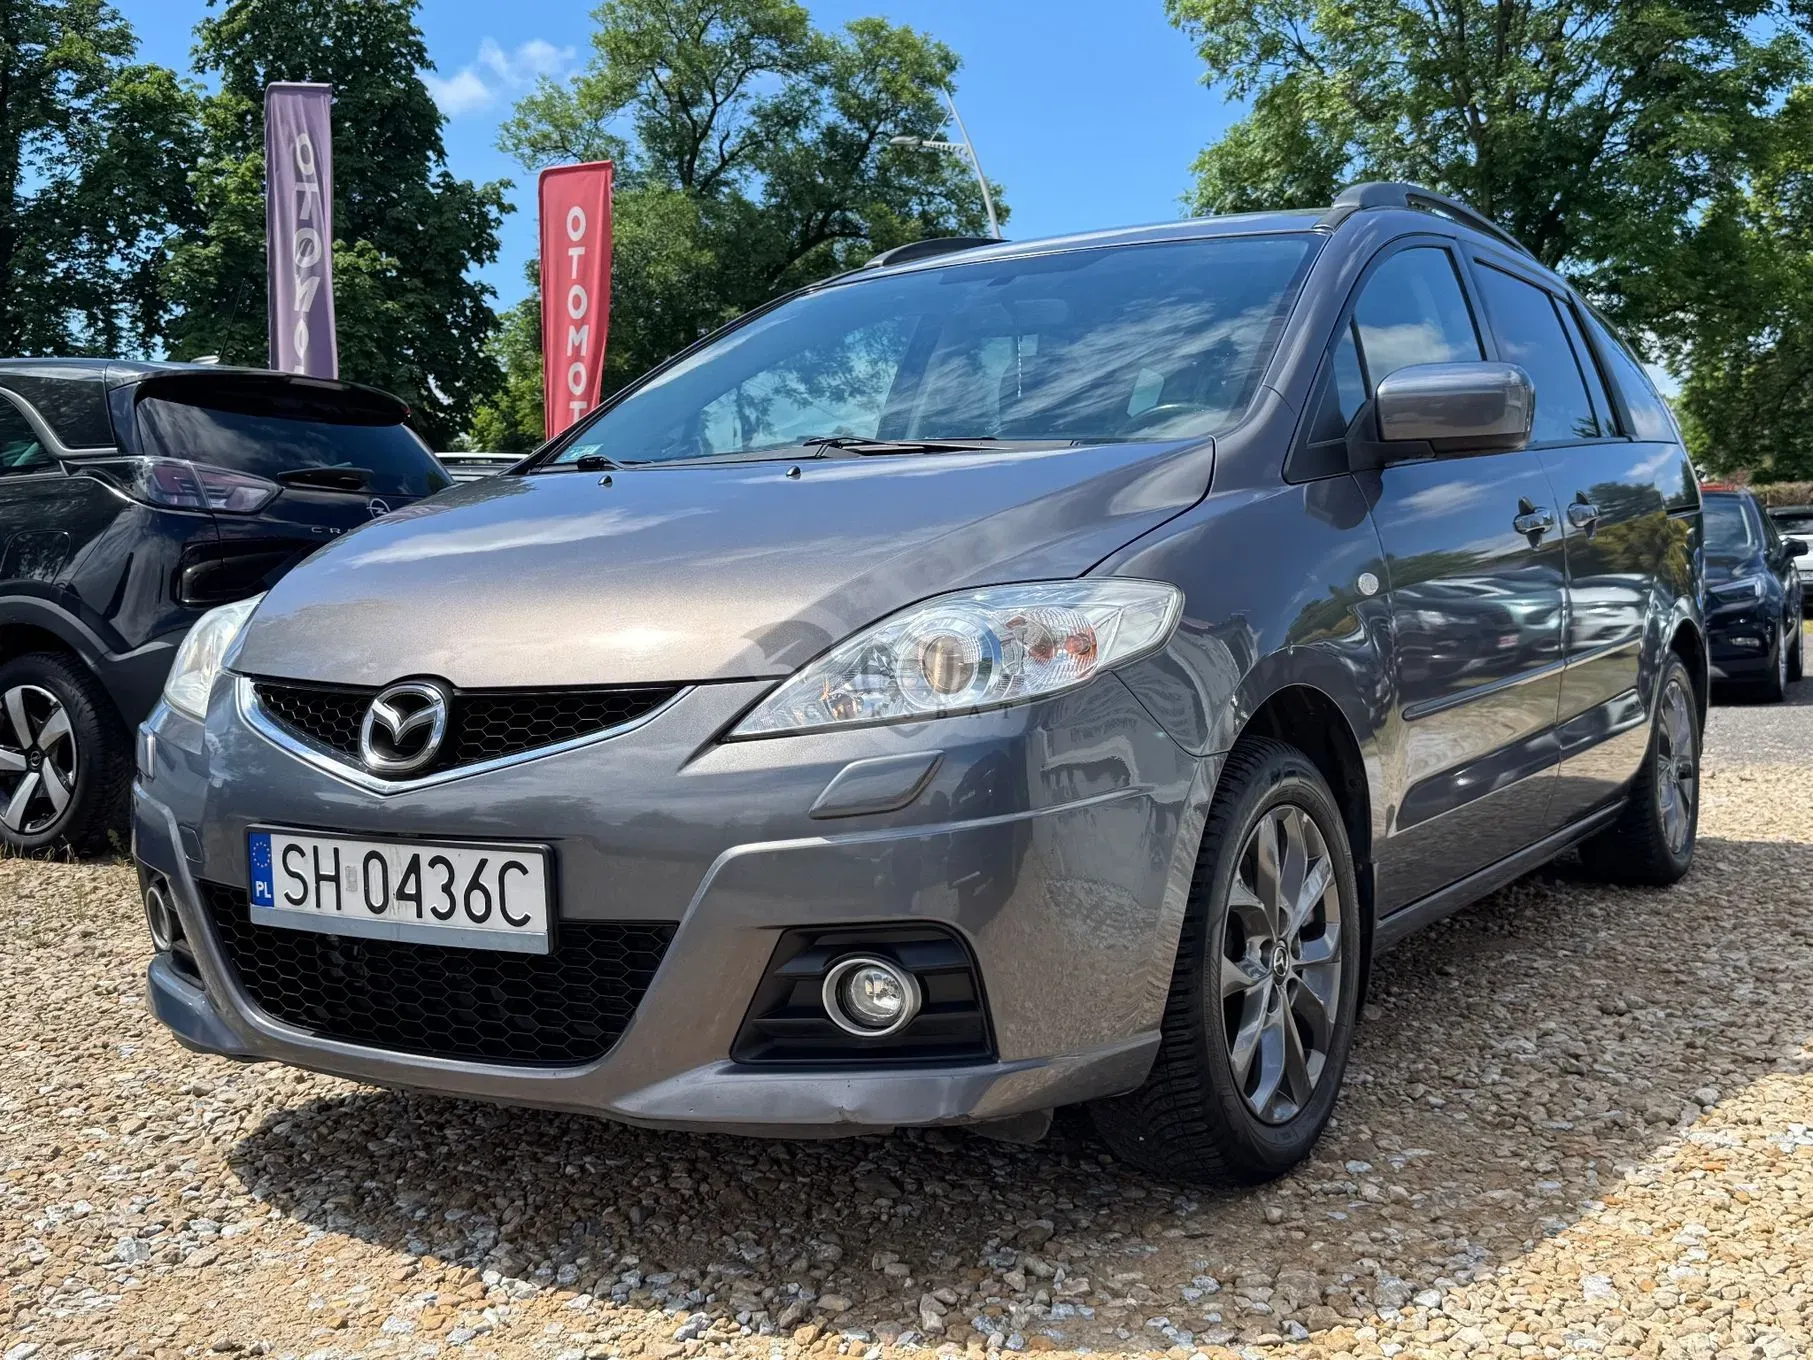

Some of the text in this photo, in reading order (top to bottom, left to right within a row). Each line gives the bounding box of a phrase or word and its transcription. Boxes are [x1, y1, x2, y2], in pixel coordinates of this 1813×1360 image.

[294, 132, 322, 375] OTOMO
[255, 880, 272, 899] PL
[281, 842, 532, 928] SH 0436C
